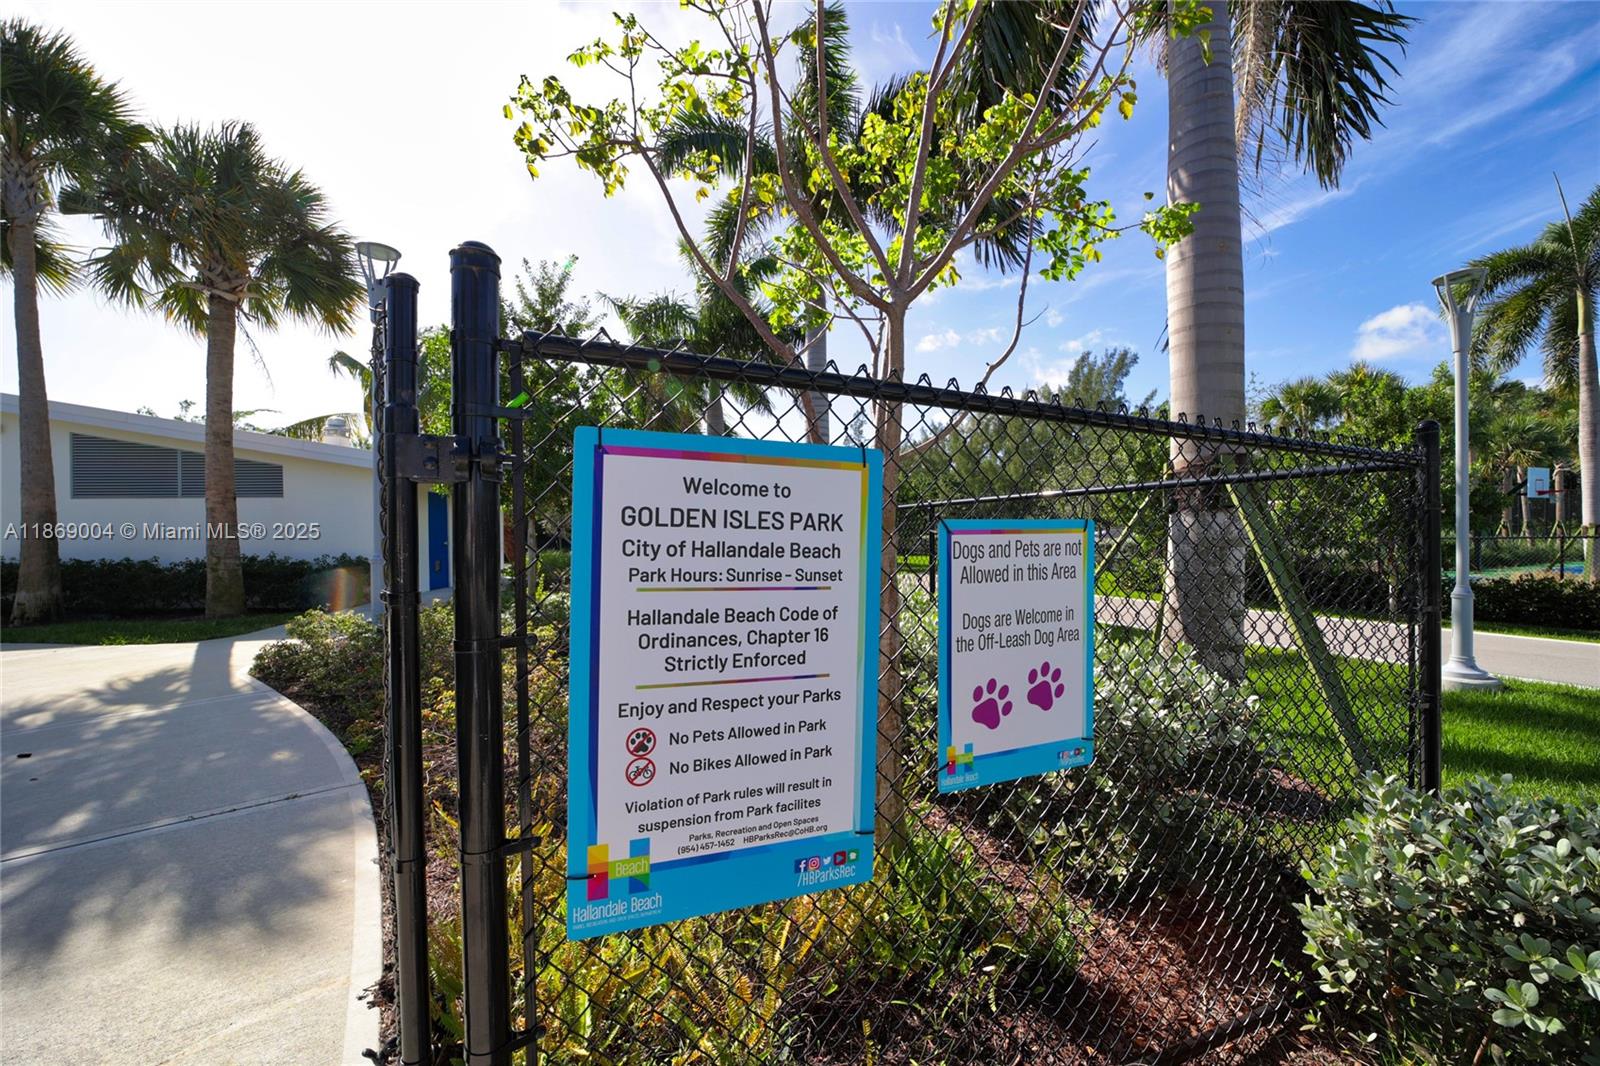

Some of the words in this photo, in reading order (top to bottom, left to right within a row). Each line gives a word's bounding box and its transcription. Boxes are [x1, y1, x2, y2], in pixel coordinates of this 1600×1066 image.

[683, 477, 769, 497] Welcome
[774, 483, 791, 498] to
[621, 506, 716, 528] GOLDEN
[724, 510, 784, 530] ISLES
[790, 512, 844, 532] PARK
[622, 539, 661, 561] City
[666, 541, 686, 557] of
[692, 541, 785, 558] Hallandale
[790, 542, 841, 559] Beach
[952, 540, 985, 564] Dogs
[988, 540, 1011, 559] and
[1015, 540, 1040, 558] Pets
[1044, 542, 1062, 556] are
[1064, 539, 1082, 556] not
[629, 567, 666, 582] Park
[671, 568, 722, 582] Hours:
[726, 568, 782, 582] Sunrise
[795, 568, 843, 582] Sunset
[960, 564, 1009, 584] Allowed
[1013, 564, 1024, 582] in
[1028, 563, 1048, 581] this
[1051, 562, 1076, 580] Area
[628, 608, 720, 626] Hallandale
[724, 607, 776, 624] Beach
[779, 606, 818, 622] Code
[822, 606, 839, 620] of
[962, 613, 991, 632] Dogs
[994, 612, 1012, 627] are
[1015, 608, 1062, 626] Welcome
[1065, 605, 1074, 621] in
[638, 632, 742, 650] Ordinances,
[747, 630, 810, 648] Chapter
[814, 628, 829, 642] 16
[956, 636, 974, 653] the
[978, 630, 1031, 650] Off-Leash
[1034, 628, 1054, 648] Dog
[1057, 626, 1080, 642] Area
[664, 654, 728, 672] Strictly
[732, 650, 807, 669] Enforced
[618, 702, 664, 720] Enjoy
[668, 698, 698, 714] and
[702, 694, 764, 713] Respect
[767, 692, 800, 708] your
[803, 688, 842, 704] Parks
[669, 732, 690, 746] No
[693, 729, 725, 744] Pets
[728, 724, 781, 740] Allowed
[784, 722, 795, 734] in
[798, 718, 826, 732] Park
[669, 761, 690, 775] No
[694, 757, 732, 773] Bikes
[734, 752, 787, 768] Allowed
[790, 748, 801, 762] in
[804, 744, 832, 759] Park
[625, 796, 684, 814] Violation
[686, 793, 700, 806] of
[702, 790, 731, 804] Park
[734, 786, 764, 800] rules
[766, 782, 786, 796] will
[788, 778, 819, 793] result
[822, 776, 832, 788] in
[638, 814, 712, 834] suspension
[714, 808, 744, 823] from
[746, 804, 774, 818] Park
[776, 797, 821, 814] facilites
[678, 842, 700, 856] (954)
[700, 838, 735, 851] 457-1452
[743, 823, 828, 844] HBParksRec@CoHB.org
[689, 832, 714, 843] Parks,
[715, 824, 758, 838] Recreation
[758, 822, 772, 833] and
[773, 818, 792, 831] Open
[793, 815, 820, 828] Spaces
[615, 858, 649, 877] Beach
[572, 900, 628, 924] Hallandale
[631, 892, 663, 913] Beach
